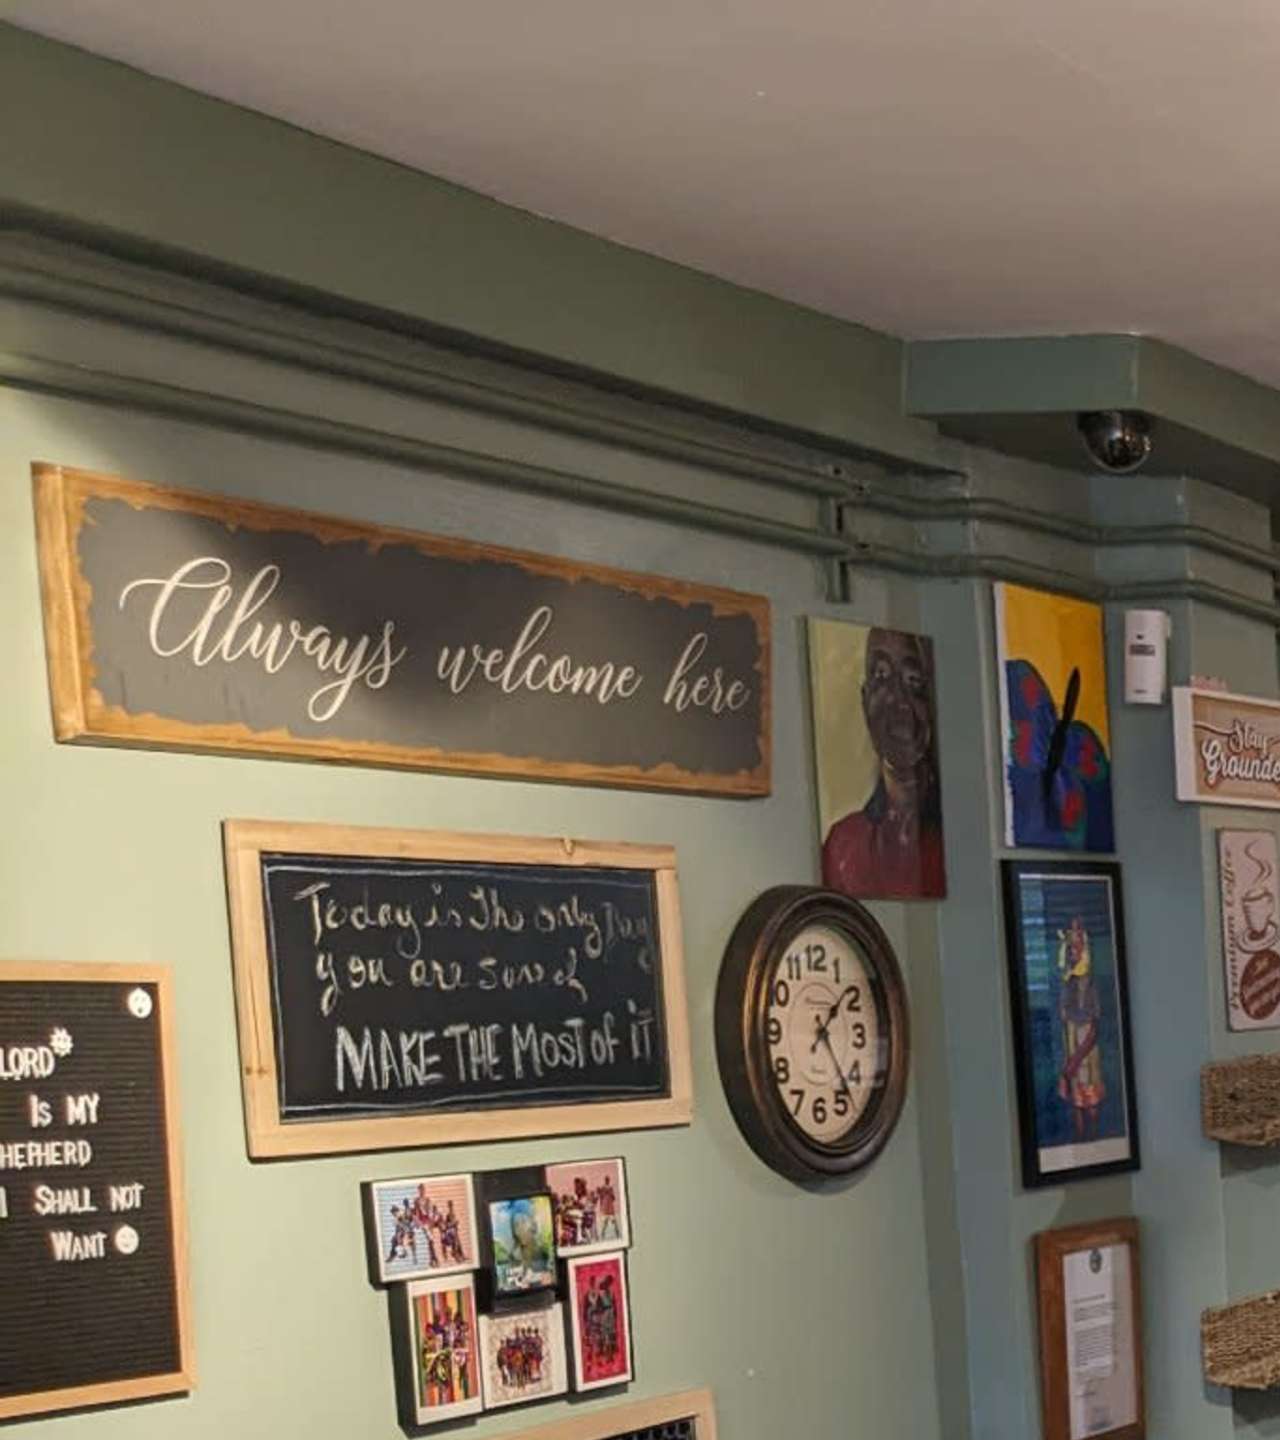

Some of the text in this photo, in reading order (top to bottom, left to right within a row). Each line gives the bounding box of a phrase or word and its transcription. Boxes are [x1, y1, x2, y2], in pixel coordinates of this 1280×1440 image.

[119, 556, 750, 722] Always welcome here
[1228, 718, 1268, 754] Stay
[294, 882, 421, 959] Today
[533, 895, 603, 957] only
[786, 955, 802, 982] 11
[805, 943, 827, 972] 12
[832, 957, 841, 984] 1
[315, 951, 393, 1018] you
[410, 958, 465, 991] are
[775, 980, 789, 1008] 0
[846, 985, 861, 1013] 2
[768, 1016, 783, 1045] 9
[852, 1023, 866, 1049] 3
[336, 1025, 446, 1092] MAKE
[444, 1022, 504, 1082] THE
[775, 1056, 790, 1085] 8
[66, 1092, 100, 1126] MY
[789, 1089, 805, 1116] 7
[813, 1097, 827, 1125] 6
[834, 1089, 849, 1116] 5
[34, 1184, 98, 1216] SHALL
[110, 1183, 144, 1213] NOT
[51, 1230, 107, 1262] WANT
